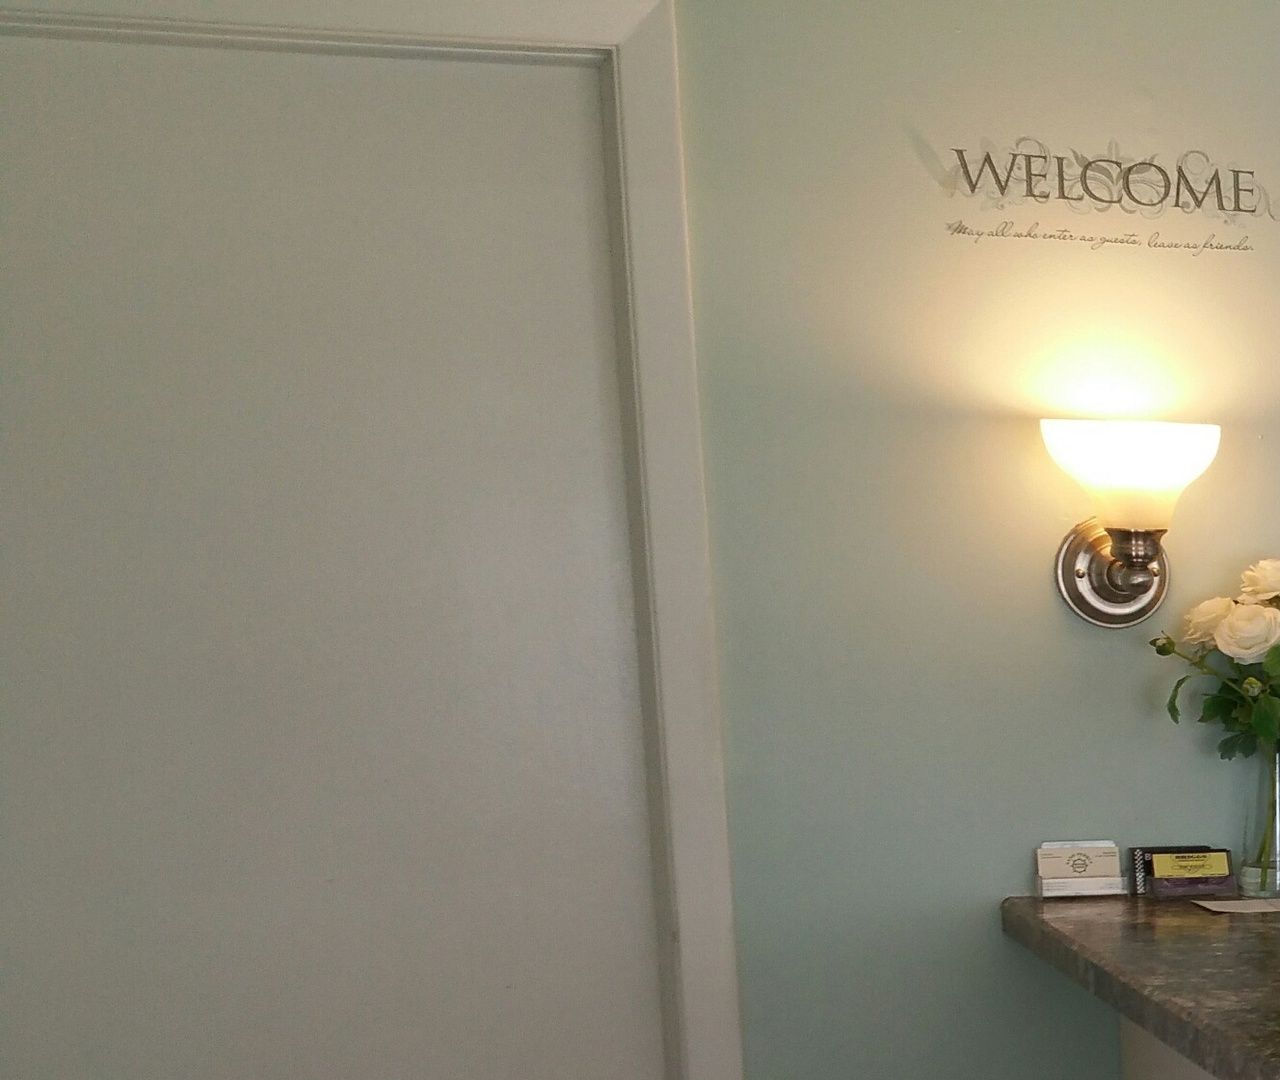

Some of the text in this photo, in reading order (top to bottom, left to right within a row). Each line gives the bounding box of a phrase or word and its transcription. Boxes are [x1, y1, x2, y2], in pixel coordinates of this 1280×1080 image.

[951, 148, 1257, 213] WELCOME
[946, 220, 1254, 256] May all who enter as guests, leave as friends.
